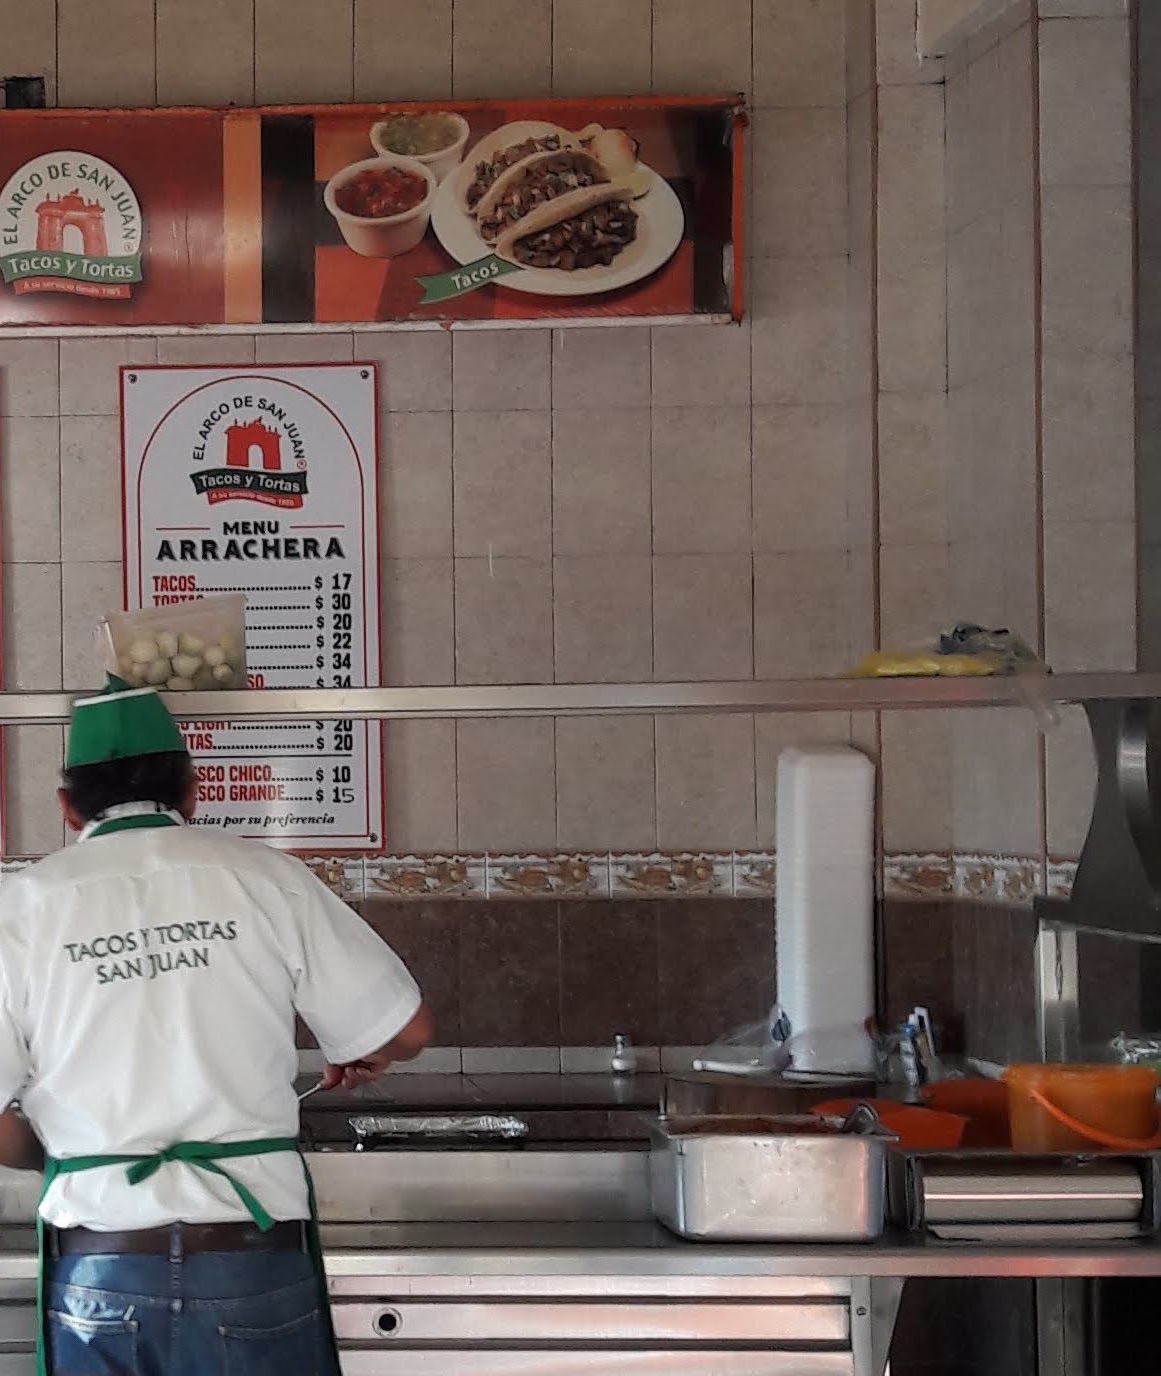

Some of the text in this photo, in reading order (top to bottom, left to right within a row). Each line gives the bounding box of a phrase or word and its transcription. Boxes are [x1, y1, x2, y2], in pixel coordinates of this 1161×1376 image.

[3, 162, 137, 245] EL ARCO DE SAN JUAN
[8, 256, 134, 278] Tacos y Tortas
[450, 262, 499, 290] Tacos
[193, 395, 305, 460] EL ARCO DE SAN JUAN
[199, 474, 300, 493] Tacos y Tortas
[223, 520, 279, 536] MENU
[155, 537, 346, 562] ARRACHERA
[152, 575, 196, 592] TACOS
[332, 574, 352, 590] 17
[332, 593, 351, 610] 30
[332, 613, 352, 630] 20
[332, 632, 352, 649] 22
[332, 653, 351, 669] 34
[334, 734, 353, 751] 20
[229, 765, 272, 782] CHICO
[332, 766, 351, 783] 10
[230, 784, 285, 801] GRANDE
[332, 786, 355, 803] 15
[224, 816, 246, 828] por
[248, 817, 261, 825] su
[263, 813, 335, 828] preferencia
[64, 932, 137, 962] TACOS
[155, 920, 237, 945] TORTAS
[96, 948, 209, 984] SAN JUAN
